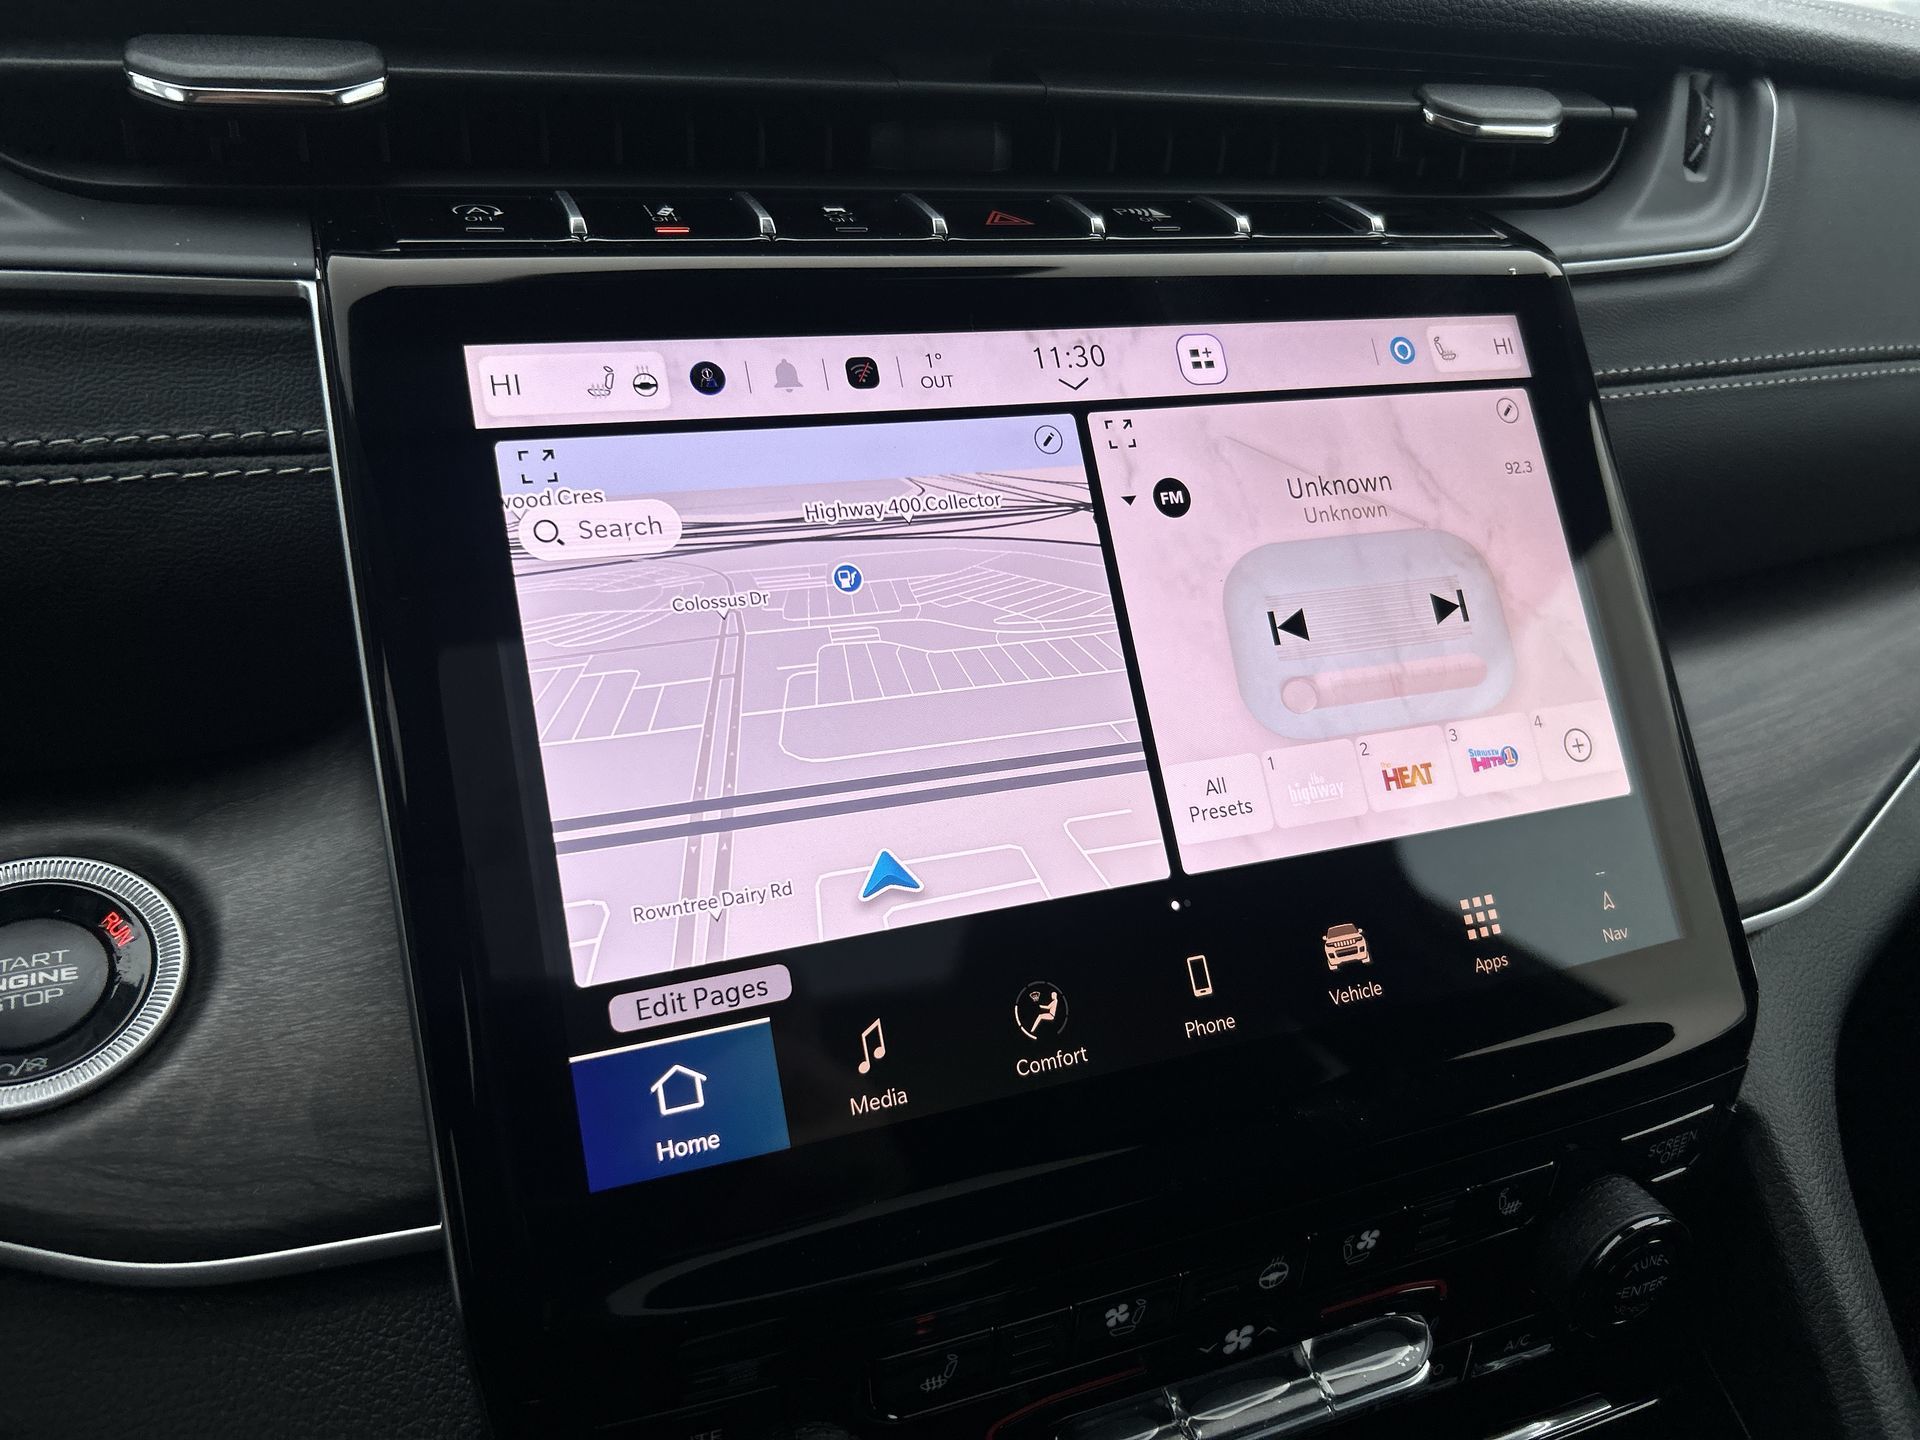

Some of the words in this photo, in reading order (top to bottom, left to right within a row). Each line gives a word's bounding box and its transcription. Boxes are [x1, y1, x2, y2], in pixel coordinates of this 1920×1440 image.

[1032, 344, 1106, 370] 11:30
[1493, 337, 1515, 356] HI
[490, 373, 521, 397] HI
[919, 374, 954, 390] OUT
[1504, 460, 1533, 476] 92.3
[1285, 470, 1394, 500] Unknown
[557, 489, 604, 506] Cres
[804, 500, 886, 522] Highway
[888, 496, 922, 514] 400
[925, 492, 1002, 512] Collector
[1159, 490, 1185, 505] FM
[1303, 502, 1389, 525] Unknown
[578, 515, 663, 540] Search
[672, 595, 747, 612] Colossus
[749, 591, 769, 605] Dr
[1534, 715, 1543, 728] 4
[1448, 728, 1458, 742] 3
[1359, 742, 1370, 757] 2
[1267, 756, 1275, 771] 1
[1205, 776, 1228, 797] All
[1381, 761, 1433, 792] HEAT
[1287, 781, 1344, 805] highway
[1188, 799, 1254, 824] Presets
[633, 896, 719, 922] Rowntree
[721, 885, 767, 912] Dairy
[769, 881, 793, 900] Rd
[102, 911, 135, 947] RUN
[1602, 925, 1629, 943] Nav
[0, 949, 71, 973] TART
[1474, 953, 1509, 974] Apps
[0, 966, 79, 992] GINE
[0, 987, 64, 1012] TOP
[635, 992, 688, 1021] Edit
[693, 978, 769, 1013] Pages
[1328, 980, 1383, 1006] Vehicle
[1184, 1013, 1236, 1039] Phone
[1016, 1046, 1089, 1077] Comfort
[850, 1087, 909, 1117] Media
[655, 1132, 721, 1162] Home
[1647, 1128, 1698, 1158] SCREEN
[1660, 1144, 1688, 1165] OFF
[1503, 1333, 1532, 1353] A/C
